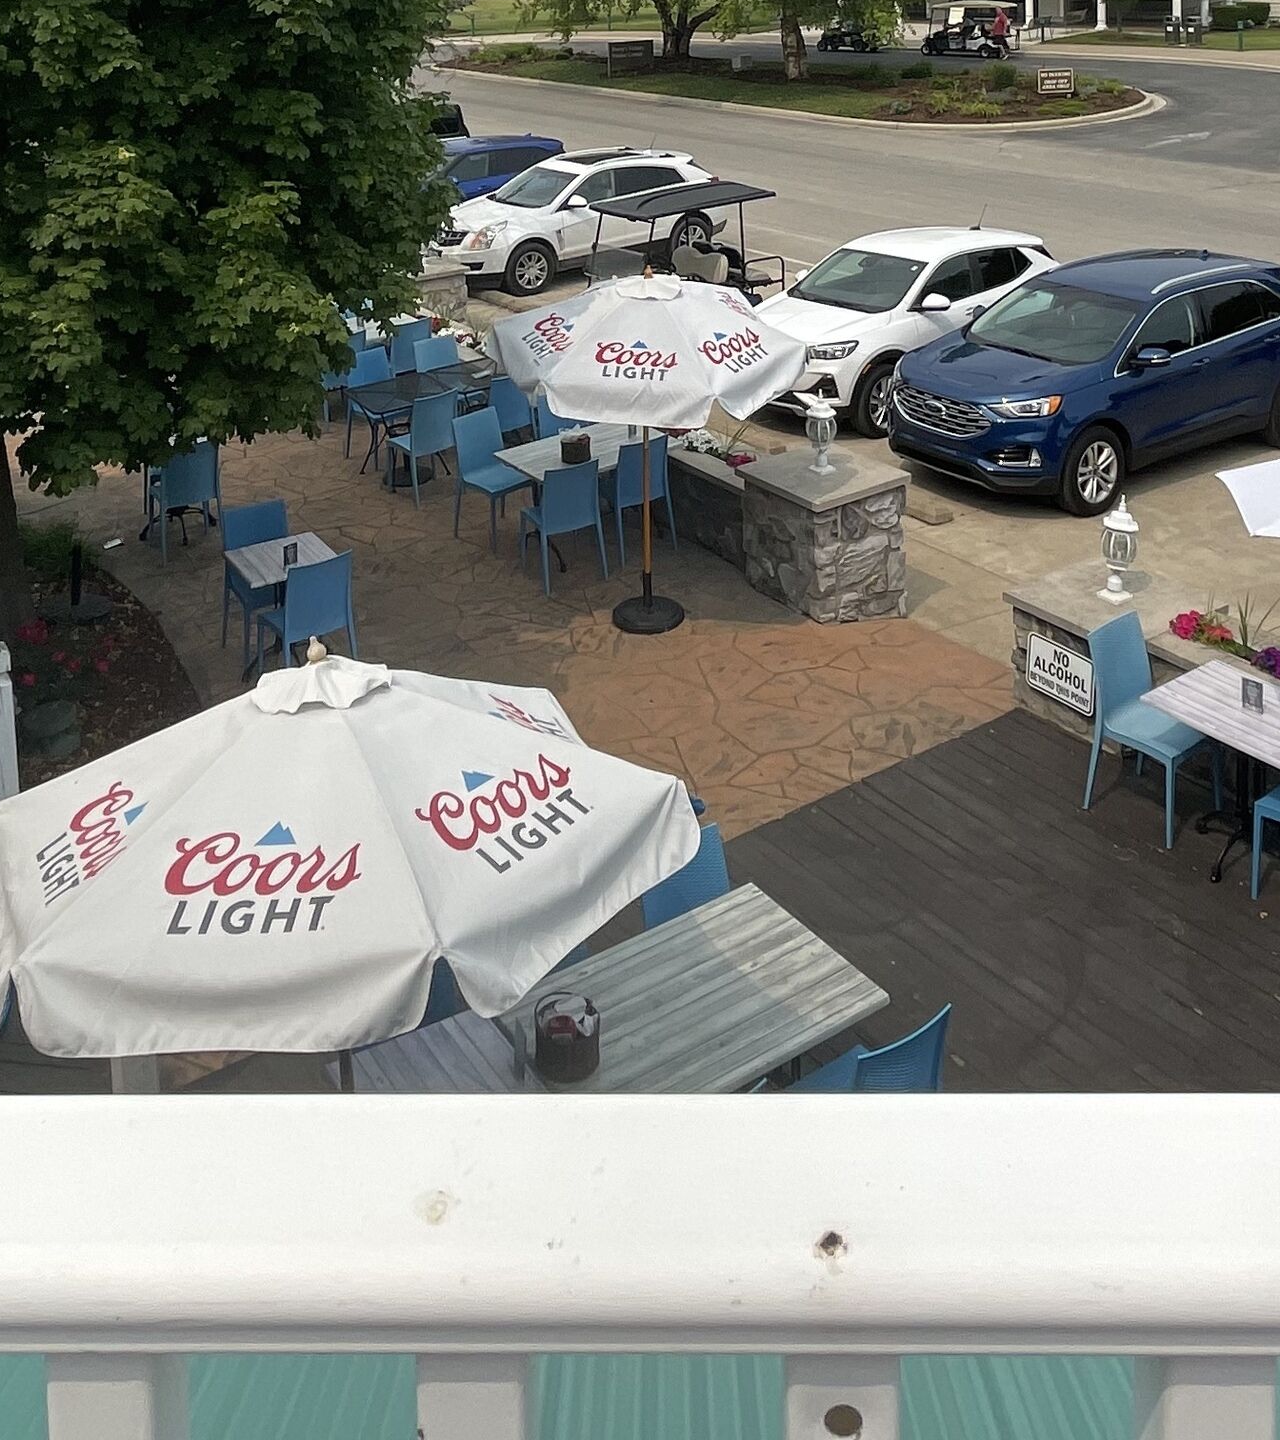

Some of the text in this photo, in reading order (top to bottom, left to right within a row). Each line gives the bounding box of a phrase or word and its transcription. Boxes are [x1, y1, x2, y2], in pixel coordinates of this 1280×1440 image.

[521, 331, 554, 360] LIGHT
[534, 312, 575, 353] Coors
[697, 326, 760, 364] Coors
[595, 341, 678, 369] Coors
[602, 365, 669, 382] LIGHT
[724, 343, 769, 373] LIGHT
[1034, 656, 1087, 694] ALCOHOL
[1053, 649, 1070, 668] NO
[1030, 671, 1090, 708] BEYOND THIS POINT
[415, 753, 572, 851] Coors
[69, 781, 128, 880] Coors
[475, 787, 591, 874] LIGHT
[36, 831, 80, 907] LIGHT
[164, 832, 363, 897] Coors
[166, 895, 336, 936] LIGHT
